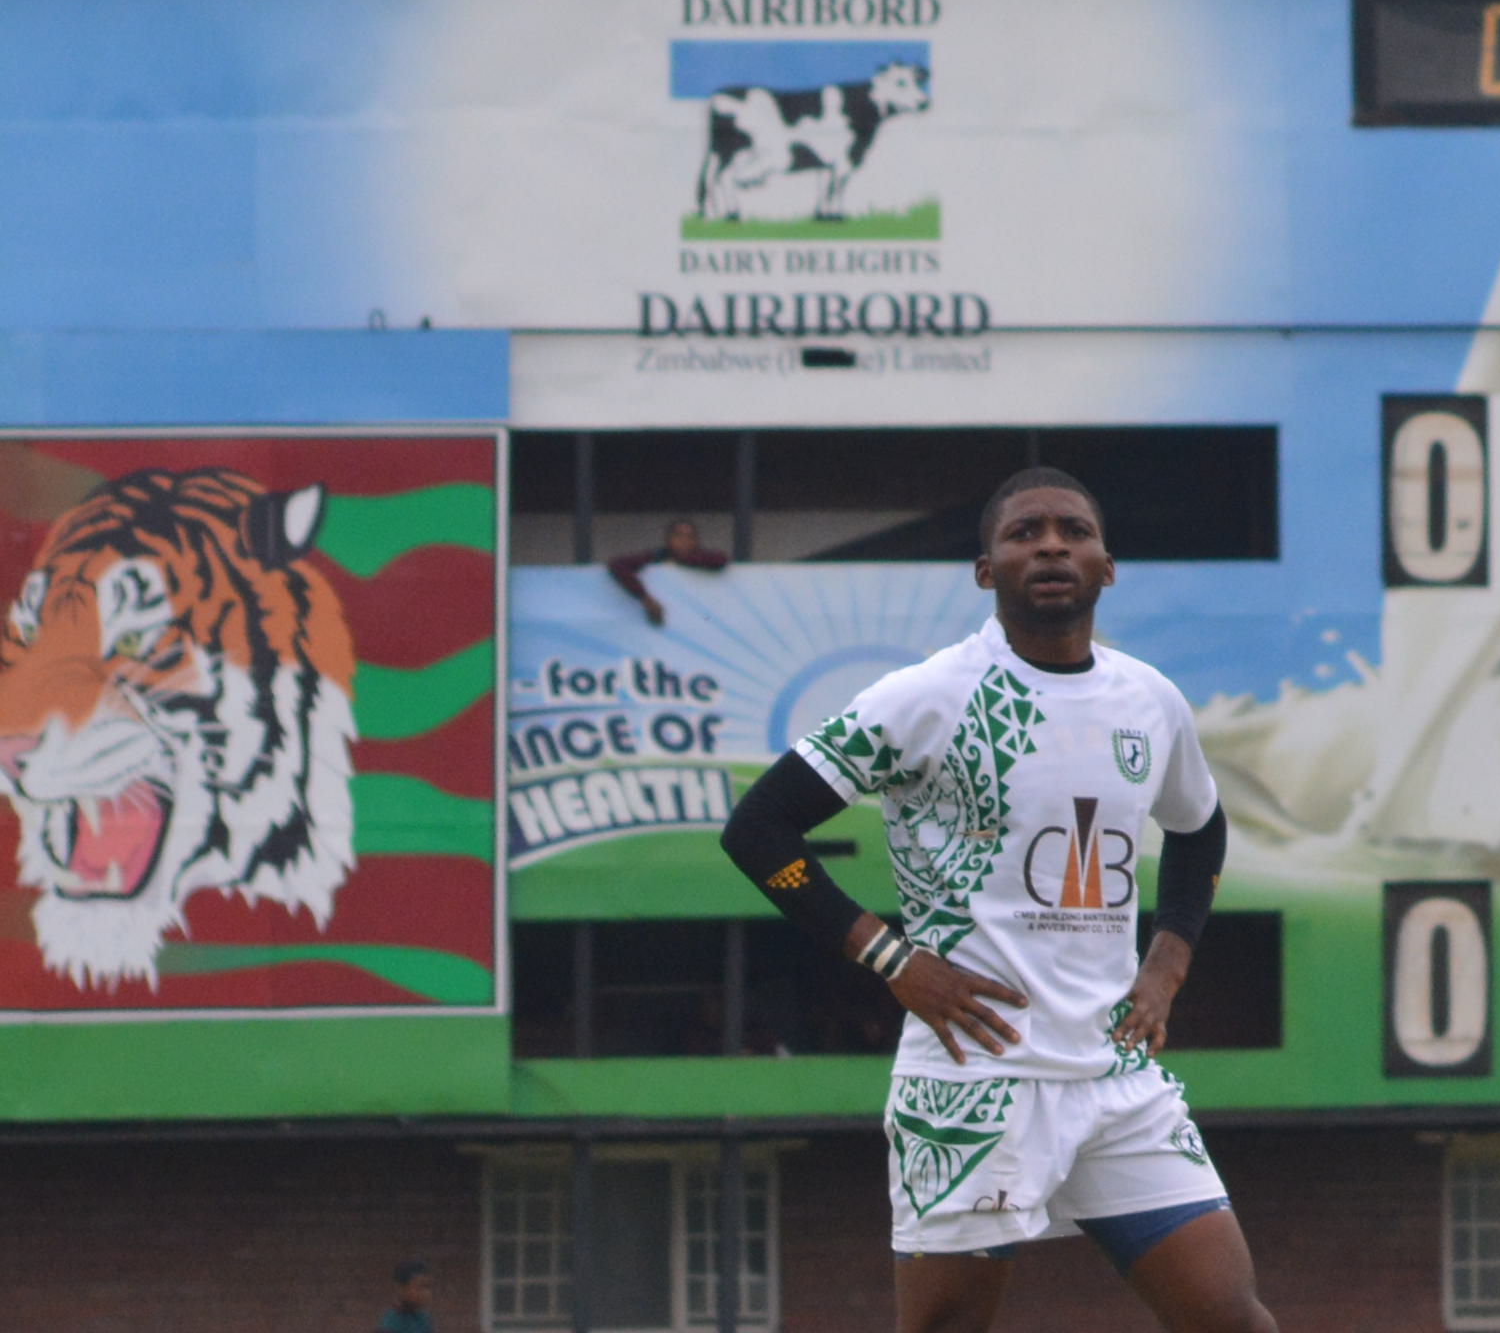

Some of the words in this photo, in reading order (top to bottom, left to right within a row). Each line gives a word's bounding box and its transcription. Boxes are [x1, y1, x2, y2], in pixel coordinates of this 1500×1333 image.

[679, 249, 774, 274] DAIRY
[785, 249, 941, 275] DELIGHTS
[636, 291, 992, 338] DAIRIBORD
[547, 659, 617, 696] for
[631, 657, 719, 702] the
[651, 712, 723, 755] OF
[511, 767, 728, 846] HEALTH
